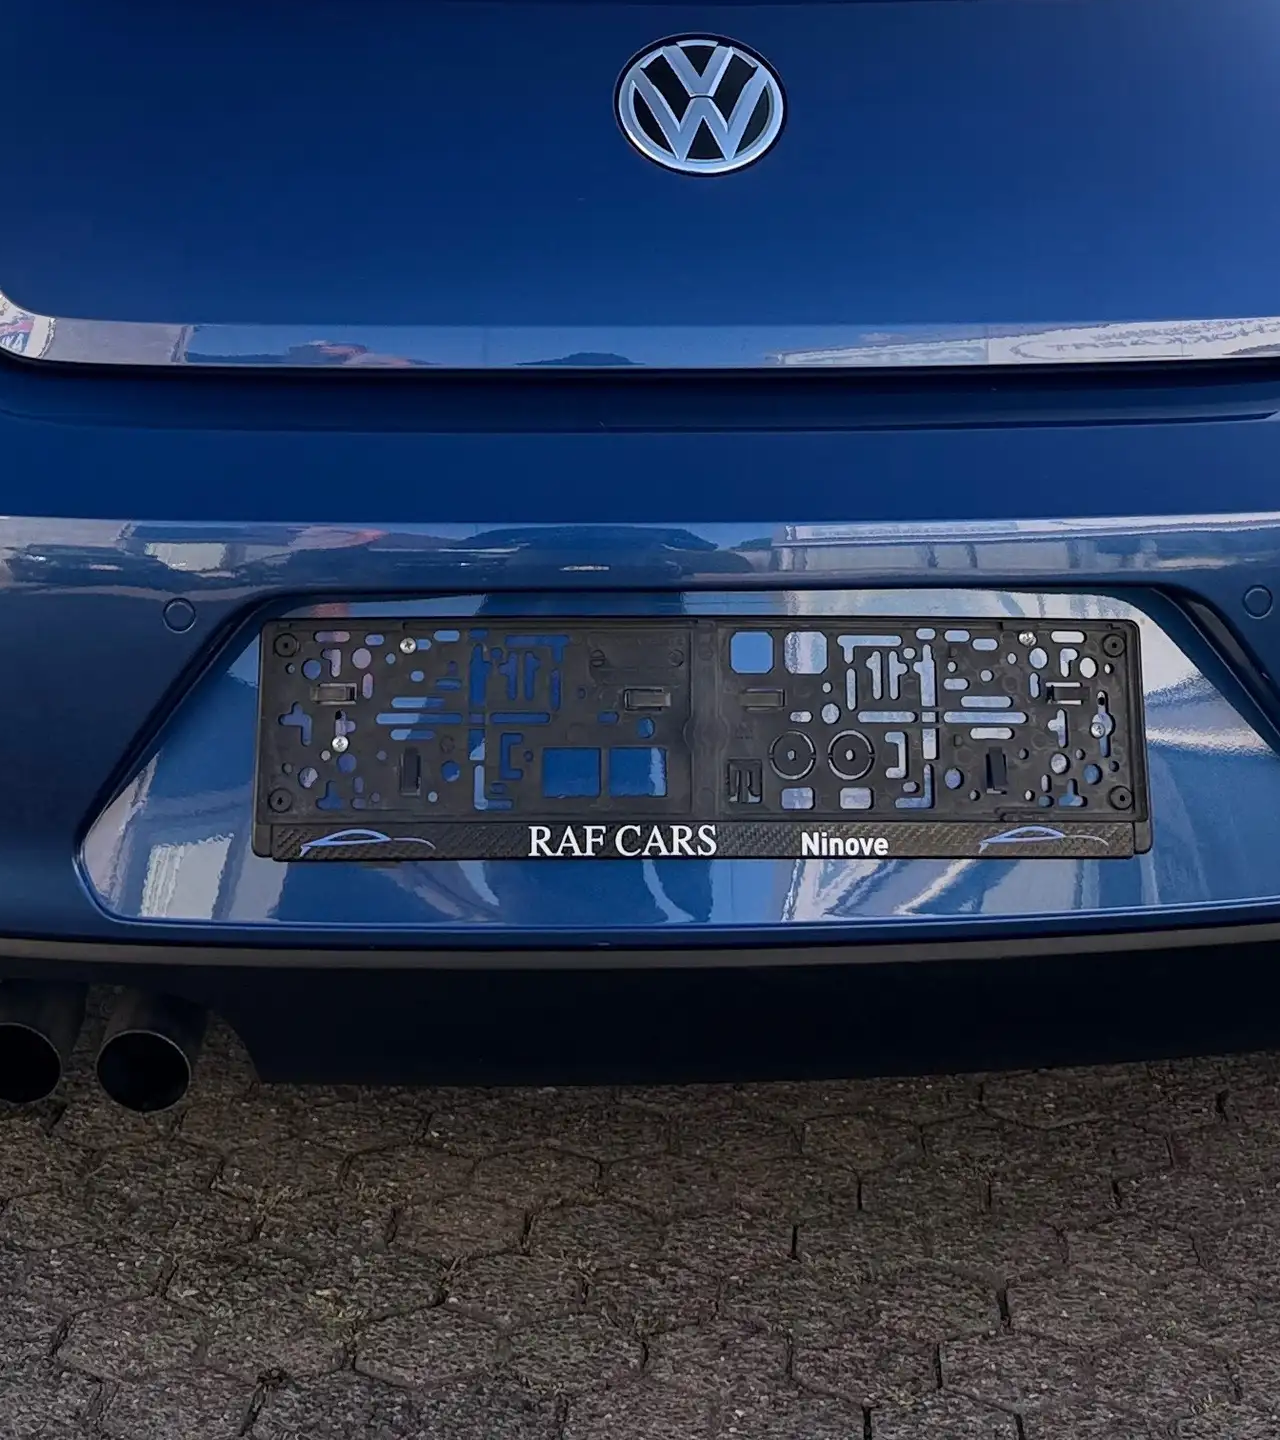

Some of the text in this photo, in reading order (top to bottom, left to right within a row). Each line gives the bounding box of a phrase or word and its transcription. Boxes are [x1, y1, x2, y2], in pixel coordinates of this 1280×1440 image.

[618, 38, 785, 175] VW
[528, 825, 889, 857] RAF CARS Ninove
